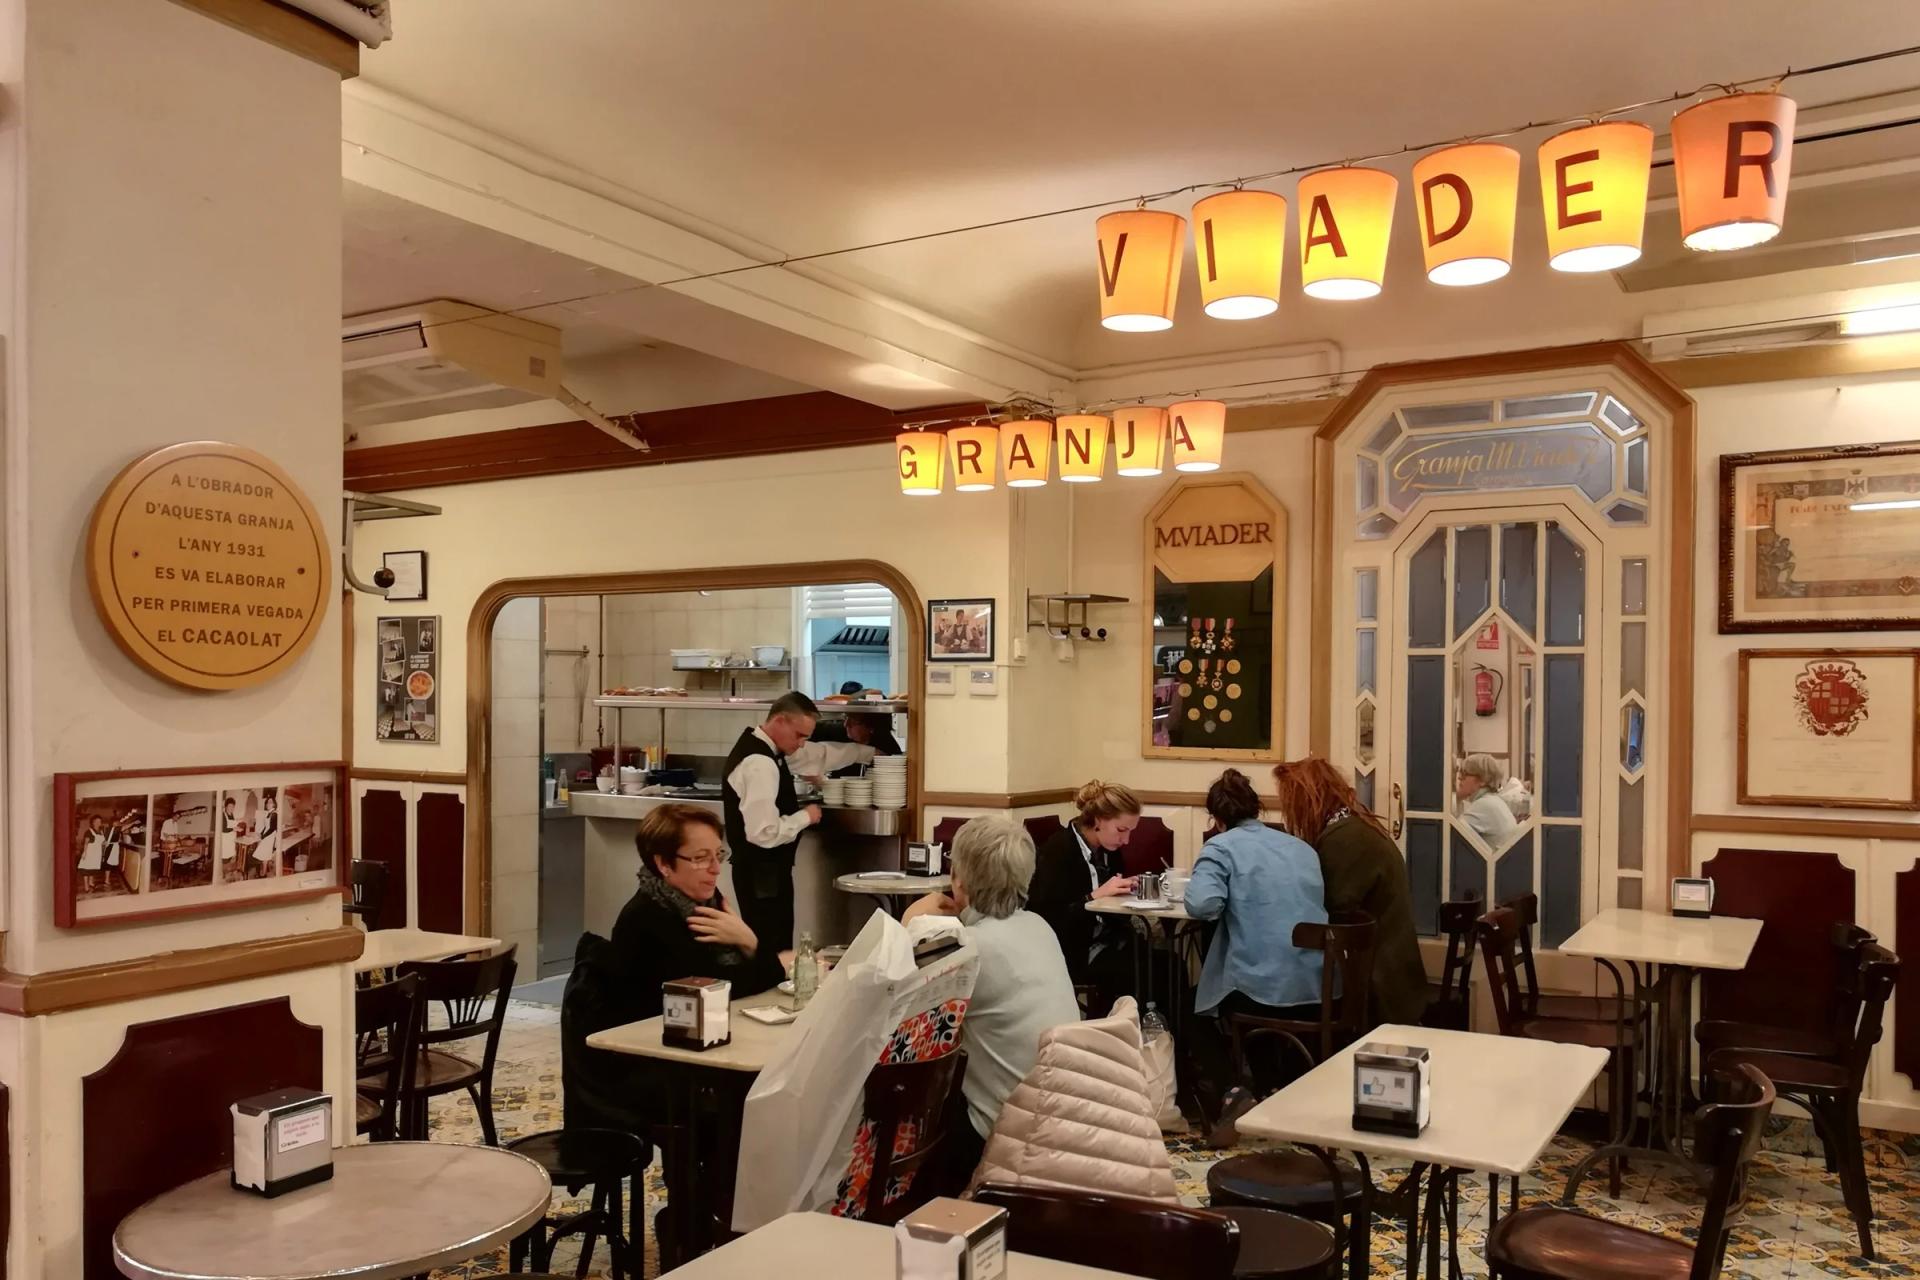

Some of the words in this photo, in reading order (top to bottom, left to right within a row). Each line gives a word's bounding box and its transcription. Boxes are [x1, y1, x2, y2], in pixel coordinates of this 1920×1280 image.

[1098, 120, 1784, 297] VIADER
[898, 415, 1196, 480] GRANJA
[1393, 443, 1483, 493] Granja
[170, 473, 182, 487] A
[187, 475, 275, 500] L'OBRADOR
[145, 501, 233, 524] D'AQUESTA
[237, 513, 295, 531] GRANJA
[178, 536, 222, 553] L'ANY
[226, 542, 266, 558] 1931
[155, 566, 176, 580] ES
[181, 568, 201, 582] VA
[205, 571, 286, 589] ELABORAR
[132, 596, 165, 611] PER
[169, 599, 241, 616] PRIMERA
[246, 604, 304, 620] VEGADA
[157, 630, 176, 643] EL
[182, 628, 283, 648] CACAOLAT
